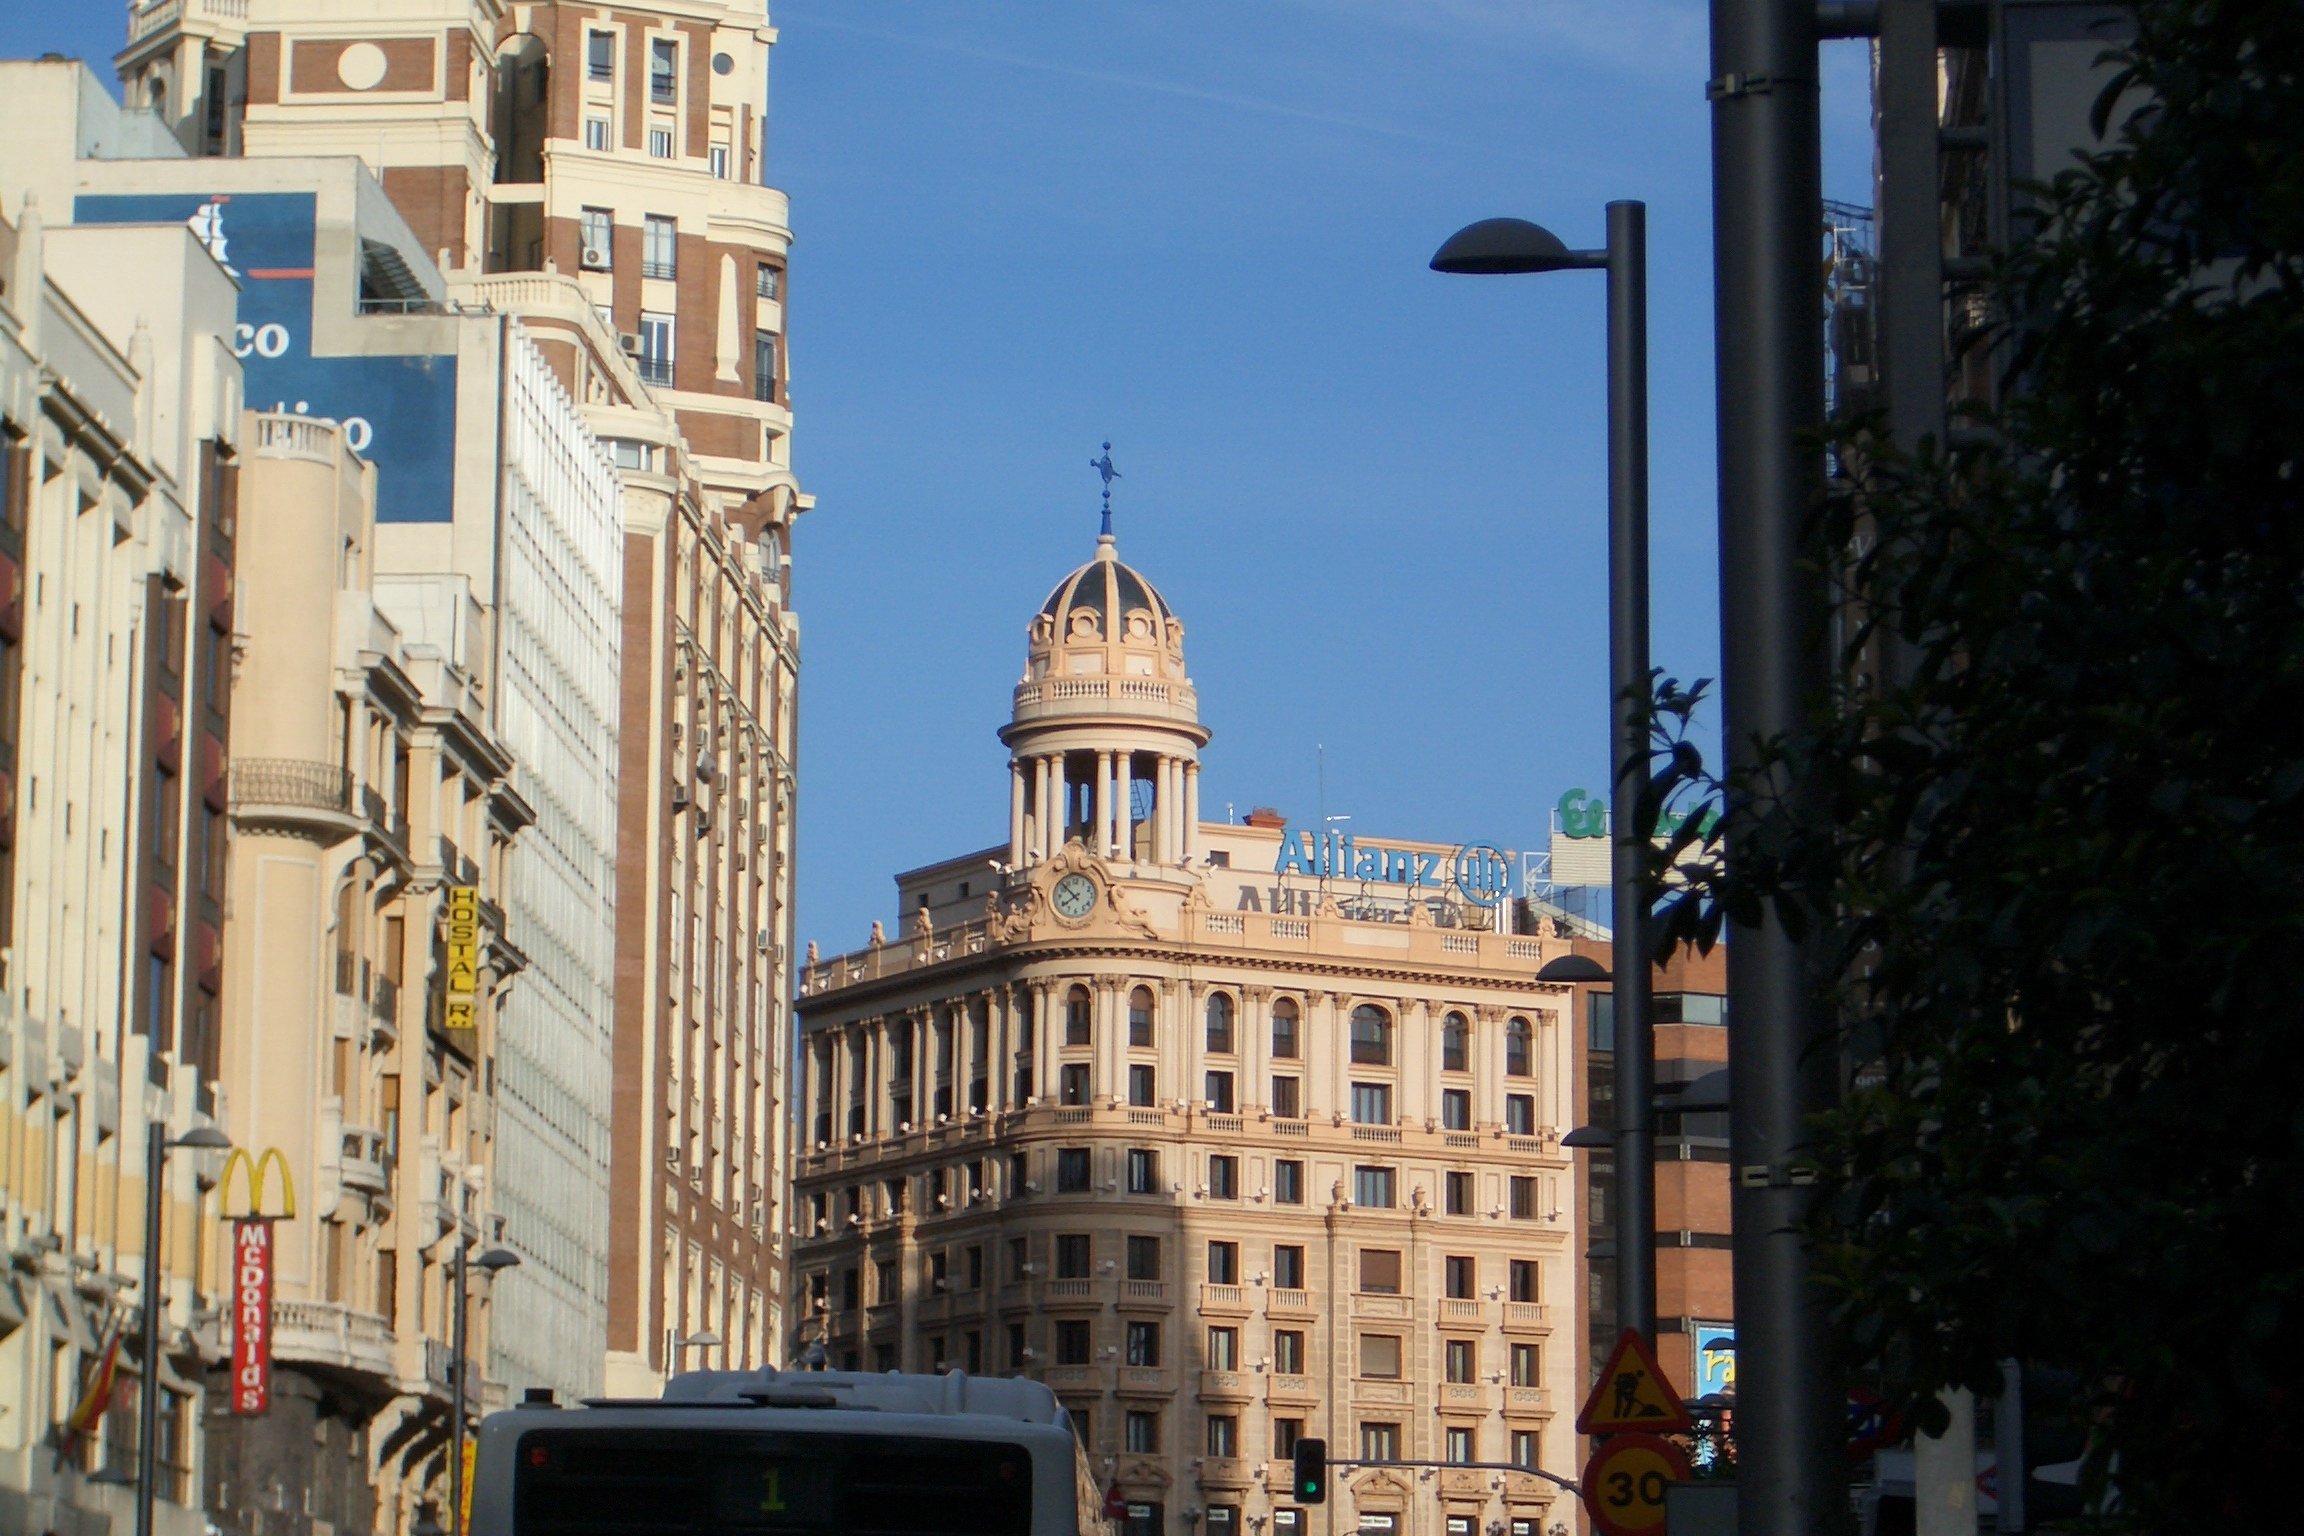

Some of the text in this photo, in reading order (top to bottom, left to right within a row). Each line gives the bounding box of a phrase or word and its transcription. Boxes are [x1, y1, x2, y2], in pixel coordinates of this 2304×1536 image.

[1274, 828, 1444, 887] Allianz
[450, 889, 475, 994] HOSTAL
[239, 1223, 267, 1411] McDonald's
[760, 1467, 785, 1511] 1
[1607, 1470, 1666, 1506] 30
